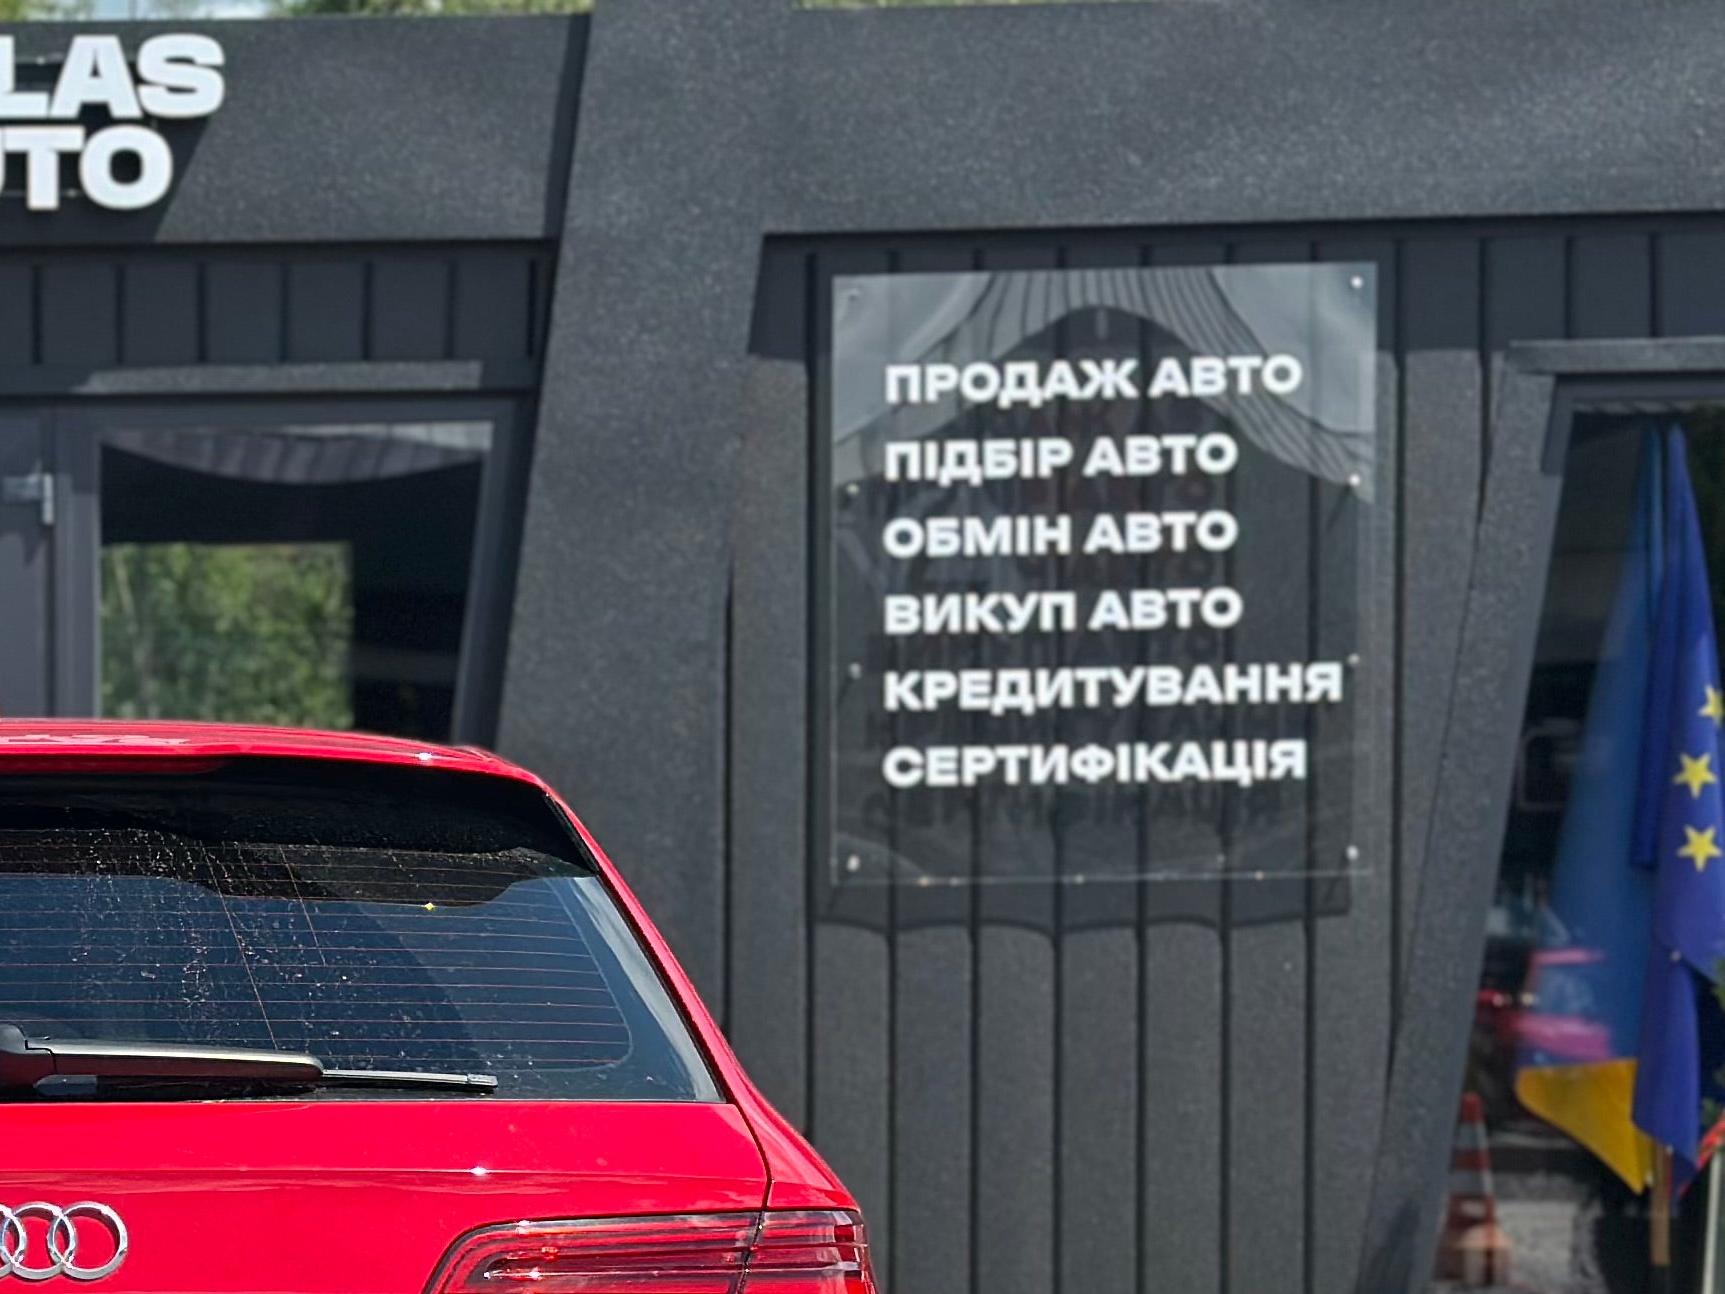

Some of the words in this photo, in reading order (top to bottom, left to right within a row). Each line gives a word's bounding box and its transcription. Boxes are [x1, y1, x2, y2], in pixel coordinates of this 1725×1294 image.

[885, 359, 1137, 406] ПРОДАЖ
[1148, 354, 1304, 398] АВТО
[884, 438, 1073, 486] ПІДБІР
[1083, 432, 1239, 476] АВТО
[882, 514, 1072, 558] ОБМІН
[1083, 511, 1239, 553] АВТО
[884, 591, 1076, 635] ВИКУП
[1087, 588, 1243, 631] АВТО
[883, 662, 1343, 715] КРЕДИТУВАННЯ
[882, 739, 1307, 787] СЕРТИФІКАЦІЯ
